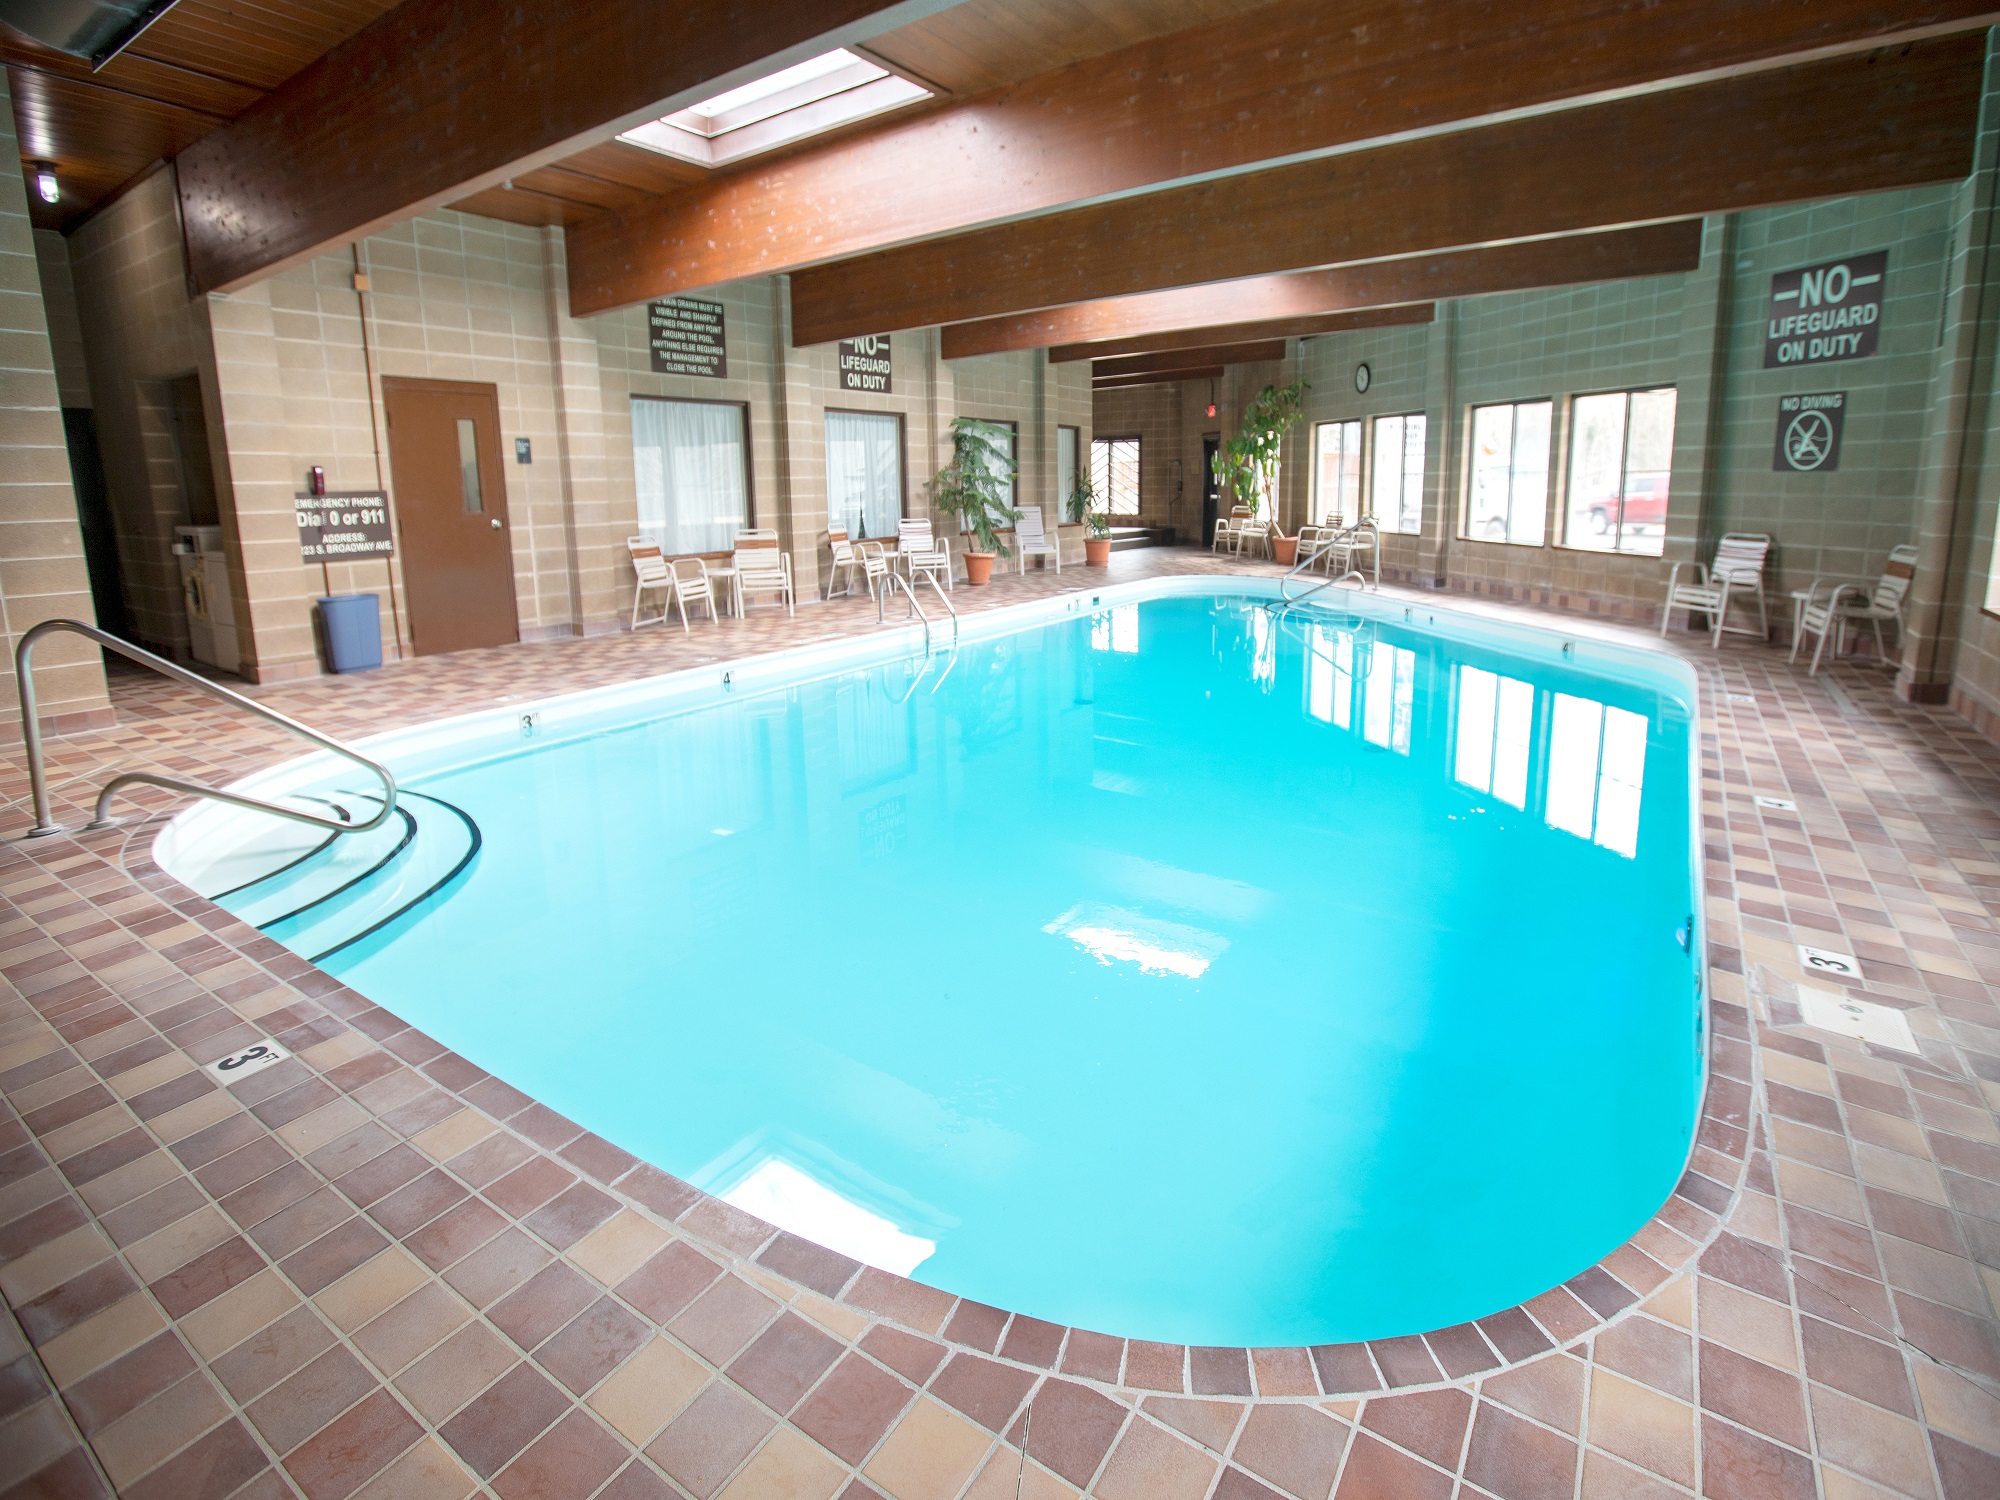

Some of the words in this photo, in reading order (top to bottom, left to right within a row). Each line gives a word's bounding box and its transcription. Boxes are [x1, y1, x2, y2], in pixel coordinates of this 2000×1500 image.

[677, 299, 698, 310] DRAINS
[699, 303, 713, 312] MUST
[714, 305, 723, 314] BE
[655, 306, 678, 317] VISIBLE
[680, 310, 692, 320] AND
[692, 312, 717, 324] SHARPLY
[1768, 302, 1878, 339] LIFEGUARD
[651, 317, 676, 327] DEFINED
[676, 321, 693, 330] FROM
[693, 323, 705, 332] ANY
[705, 324, 722, 334] POINT
[662, 329, 686, 340] AROUND
[687, 332, 698, 341] THE
[698, 334, 715, 344] POOL.
[652, 339, 681, 350] ANYTHING
[681, 343, 696, 352] ELSE
[696, 344, 724, 356] REQUIRES
[1777, 340, 1805, 363] ON
[1808, 332, 1863, 359] DUTY
[659, 351, 671, 360] THE
[671, 352, 709, 364] MANAGEMENT
[710, 356, 718, 366] TO
[841, 354, 891, 374] LIFEGUARD
[666, 362, 685, 372] CLOSE
[686, 364, 697, 373] THE
[697, 365, 714, 375] POOL.
[847, 372, 861, 388] ON
[862, 374, 886, 390] DUTY
[1781, 397, 1800, 411] NO
[1800, 393, 1843, 410] DIVING
[294, 497, 350, 510] EMERGENCY
[351, 497, 384, 508] PHONE:
[296, 511, 327, 527] Dia
[342, 512, 359, 526] or
[361, 508, 385, 525] 911
[322, 532, 367, 544] ADDRESS:
[316, 544, 326, 555] S.
[326, 542, 375, 554] BROADWAY
[375, 540, 393, 551] AVE.
[723, 672, 730, 683] 4
[522, 715, 533, 729] 3
[1808, 956, 1850, 972] 3
[217, 1046, 268, 1070] 3
[258, 1052, 279, 1064] FT
